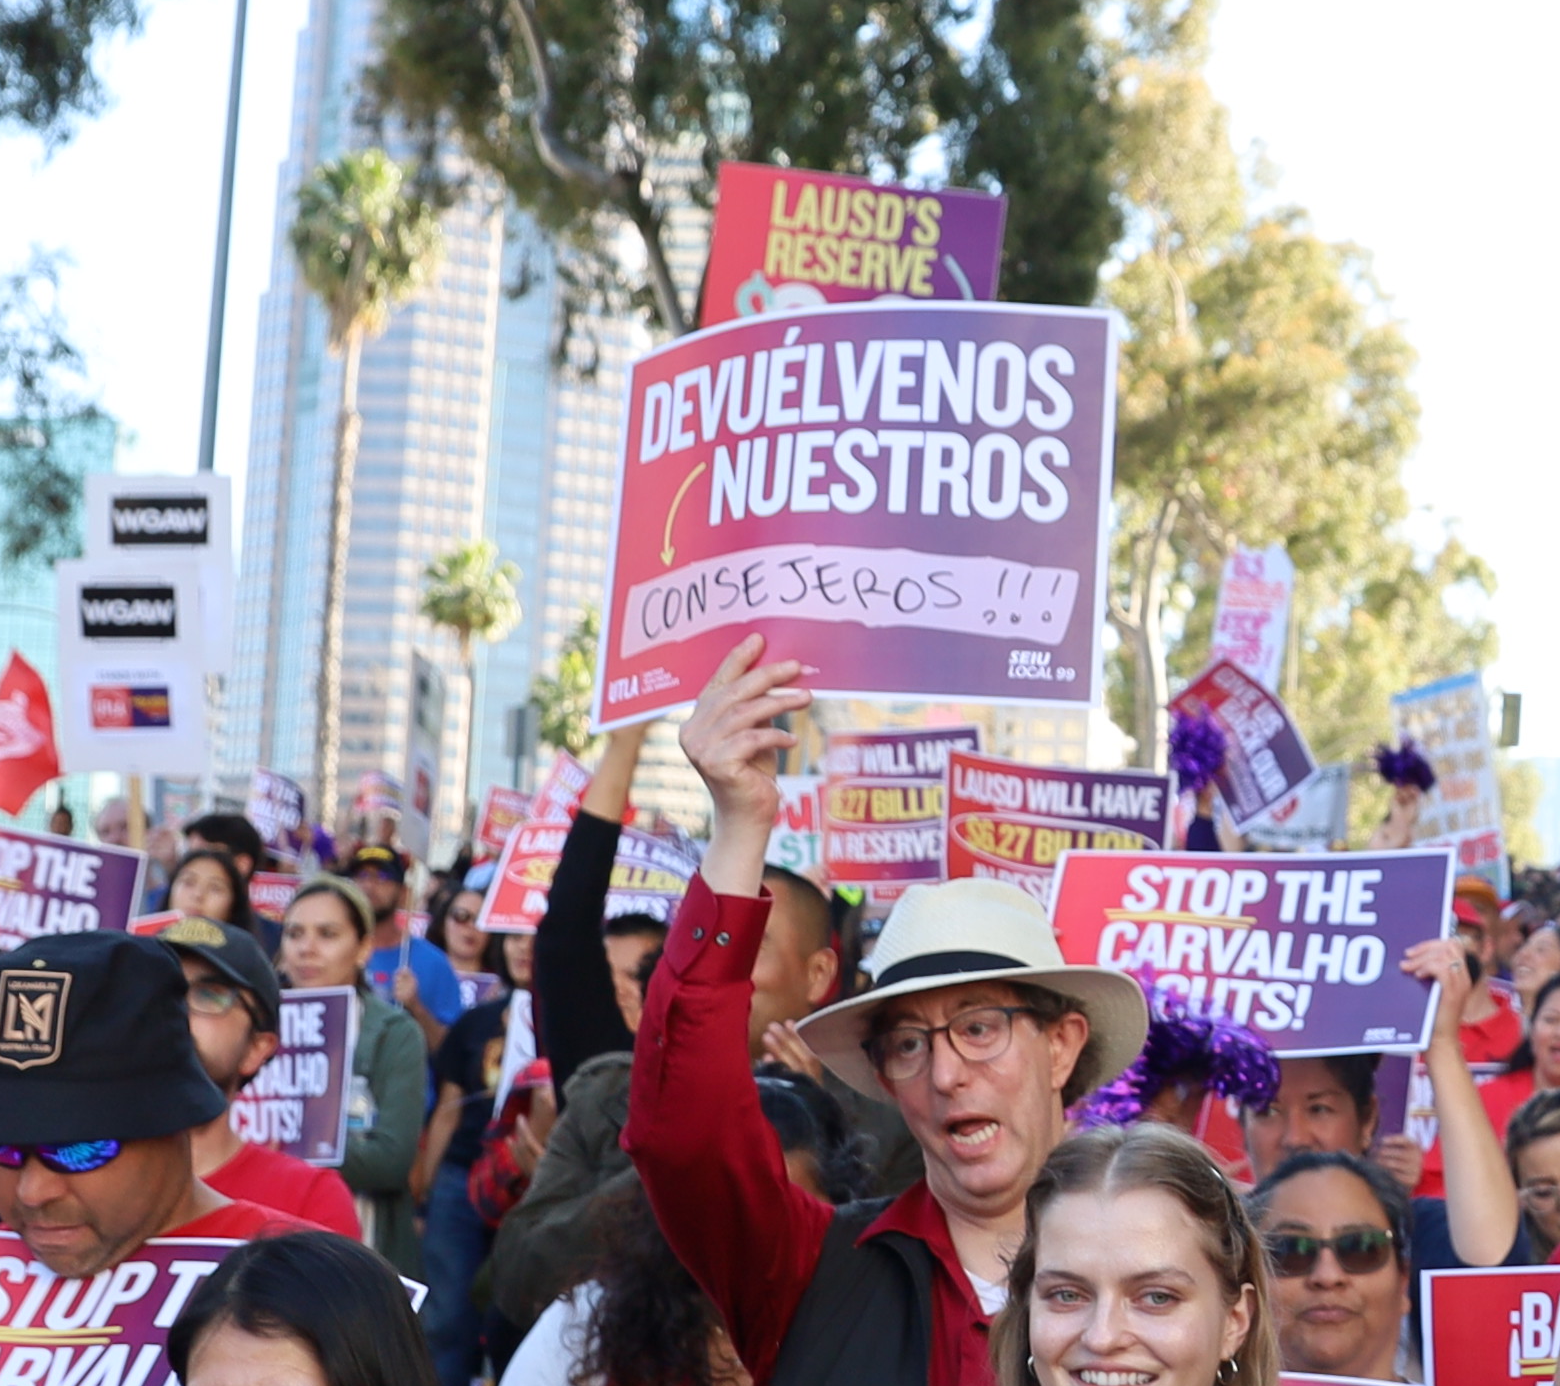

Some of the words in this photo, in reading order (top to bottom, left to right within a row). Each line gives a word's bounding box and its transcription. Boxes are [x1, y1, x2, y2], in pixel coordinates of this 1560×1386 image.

[771, 180, 942, 246] LAUSD'S
[764, 229, 938, 297] RESERVE
[640, 326, 1076, 465] DEVUÉLVENOS
[708, 427, 1072, 526] NUESTROS
[643, 555, 962, 640] CONSEJEROS
[1008, 666, 1053, 681] LOCAL
[1055, 667, 1076, 682] 99
[1009, 650, 1051, 666] SEIU
[608, 675, 639, 704] UTLA
[870, 784, 944, 822] BILLIO
[954, 764, 1023, 811] LAUSD
[1026, 777, 1088, 819] WILL
[1091, 786, 1163, 823] HAVE
[844, 829, 944, 864] RESERVE
[962, 815, 1031, 861] $6.27
[32, 843, 104, 900] THE
[1121, 865, 1267, 917] STOP
[1275, 869, 1382, 926] THE
[1097, 921, 1386, 984] CARVALHO
